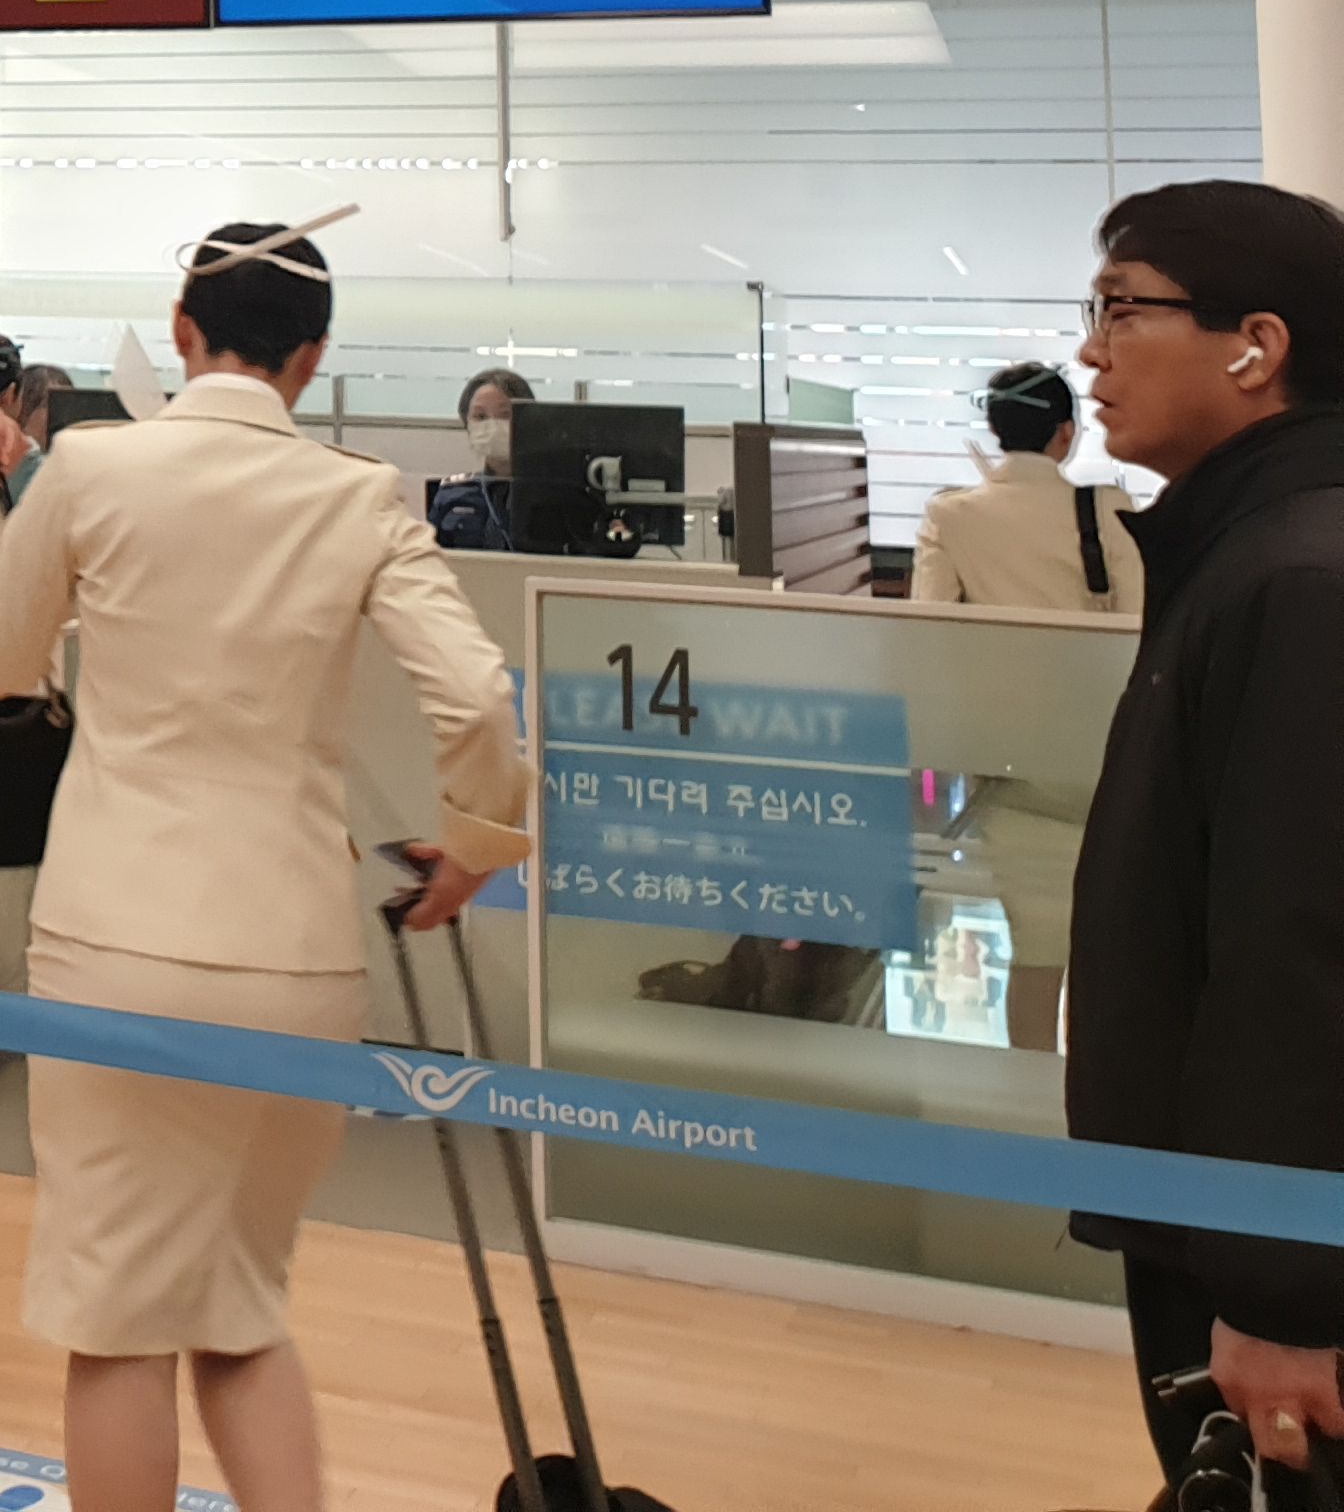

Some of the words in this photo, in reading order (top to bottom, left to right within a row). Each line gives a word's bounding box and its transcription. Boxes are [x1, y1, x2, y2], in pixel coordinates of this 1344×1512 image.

[607, 643, 699, 736] 14
[545, 771, 600, 806] 시만
[615, 773, 708, 816] 기다려
[727, 784, 867, 827] 주십시오.
[488, 1088, 619, 1131] Incheon
[631, 1109, 758, 1152] Airport
